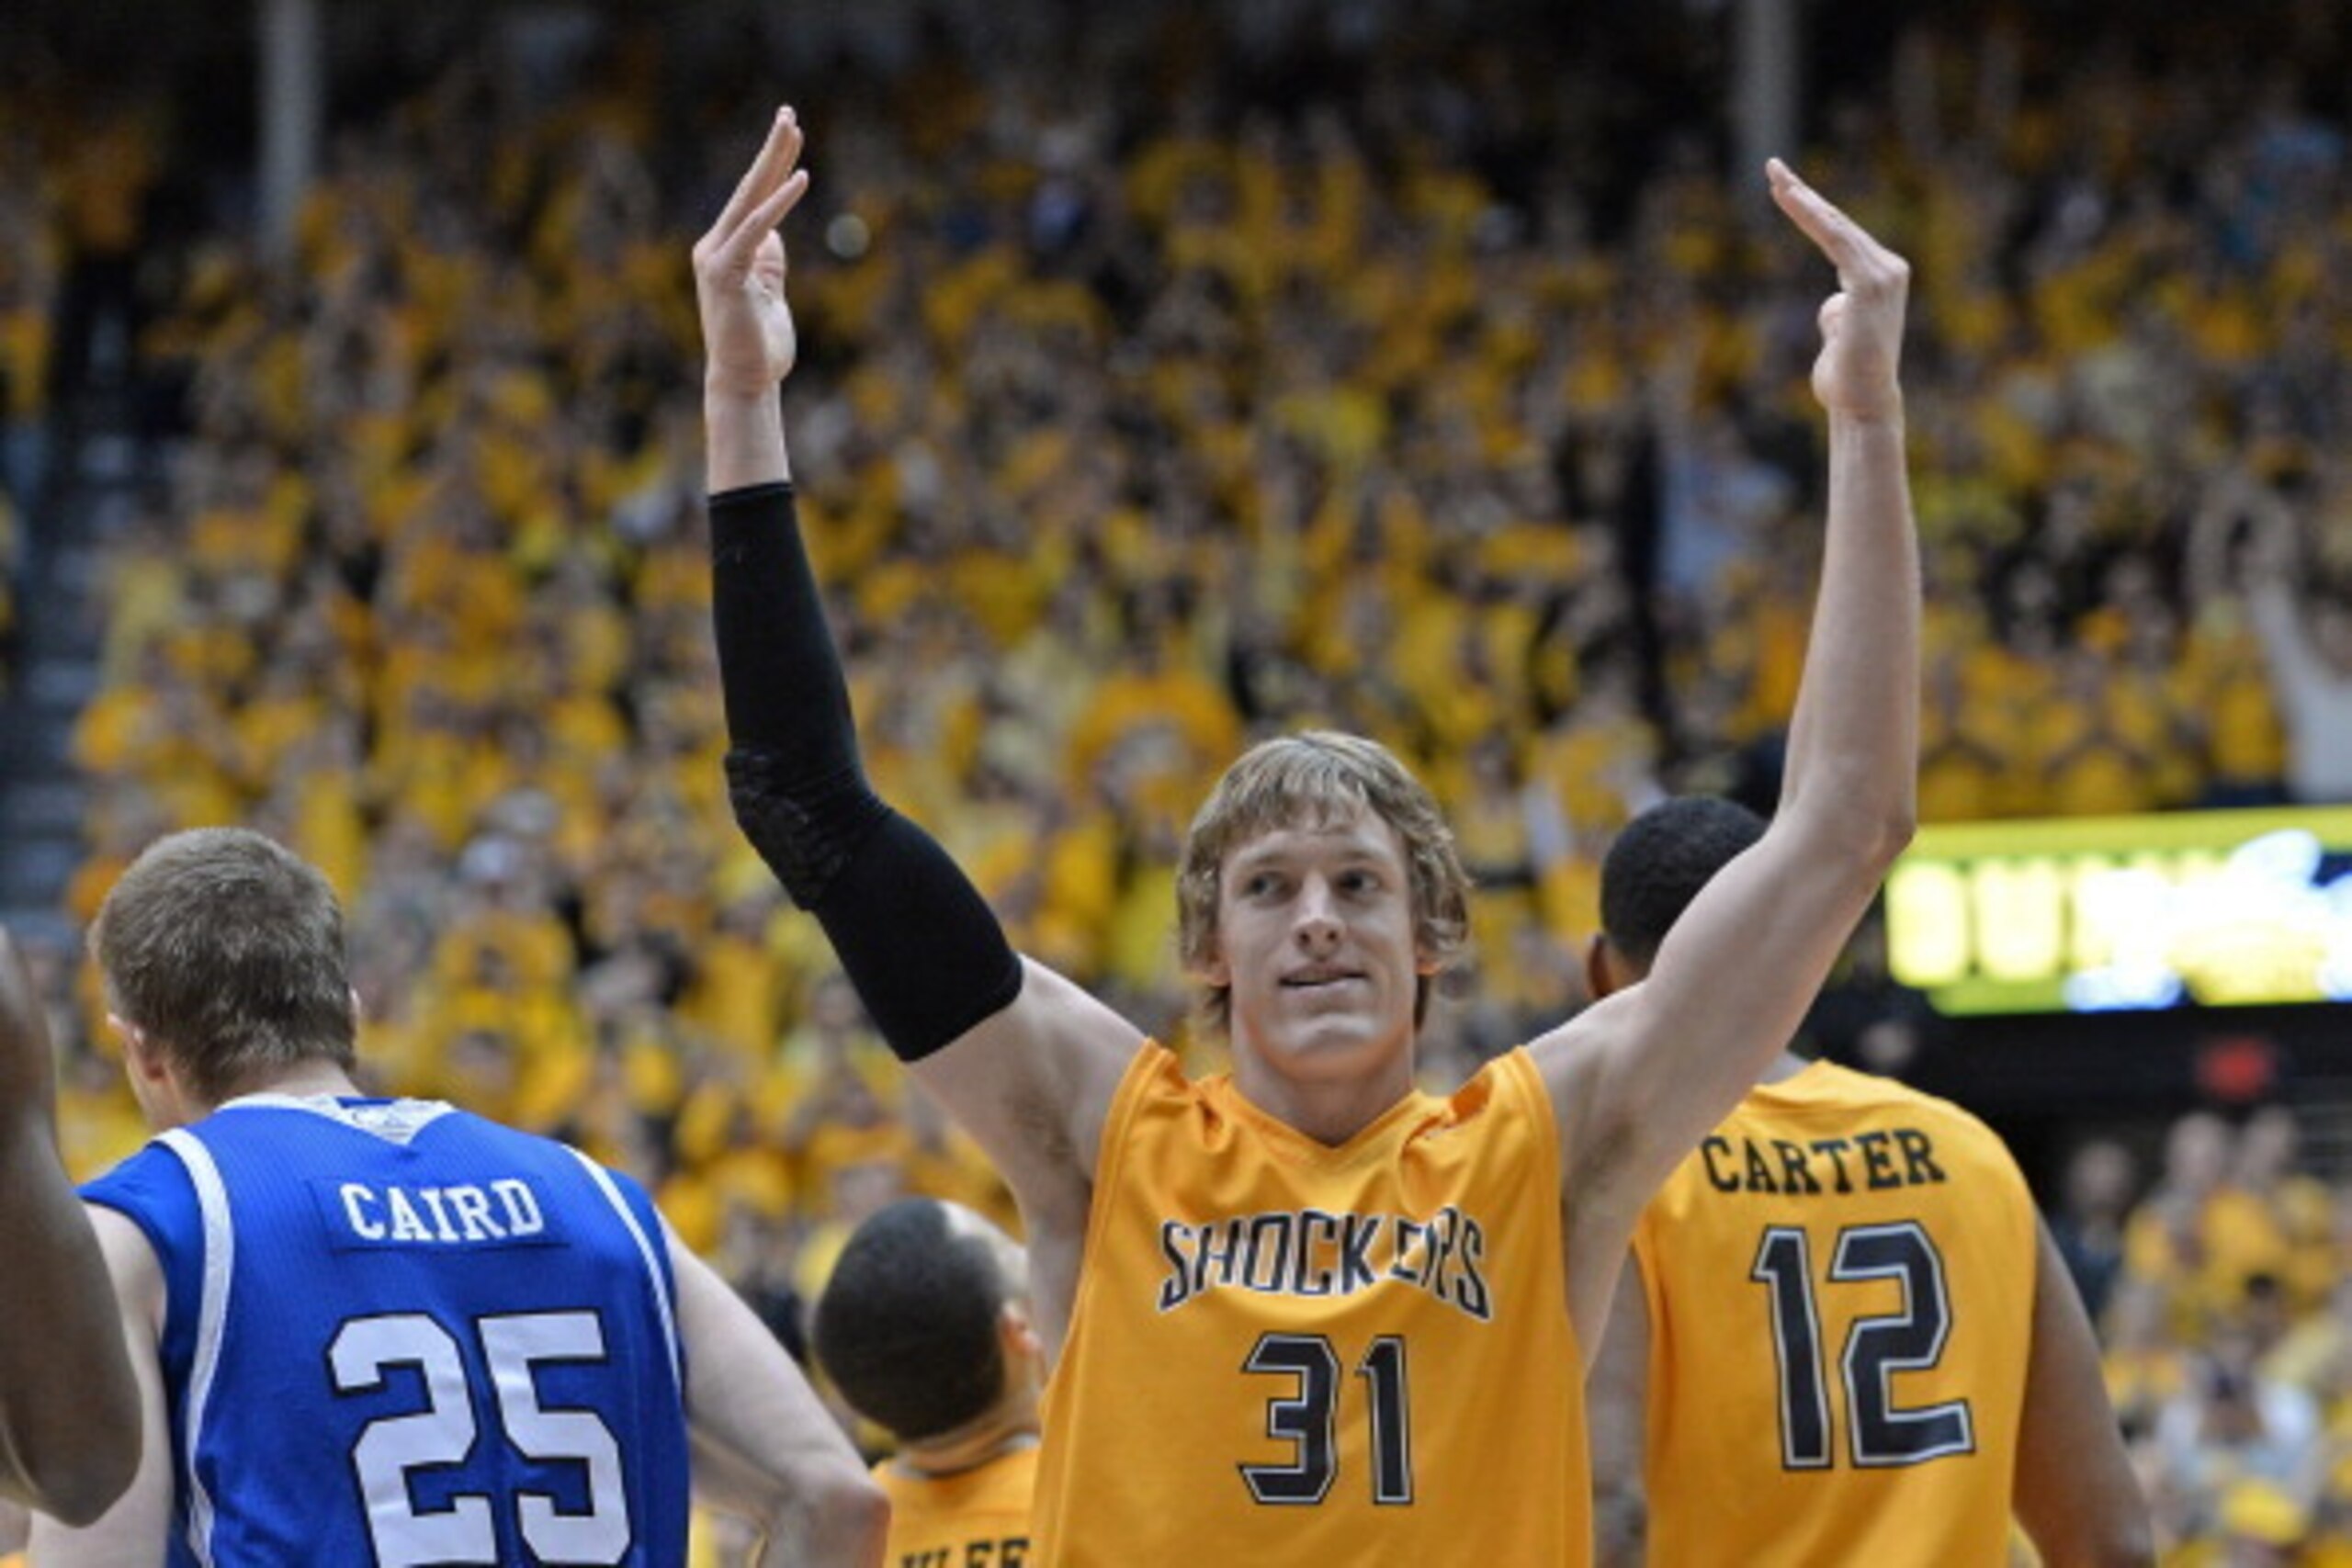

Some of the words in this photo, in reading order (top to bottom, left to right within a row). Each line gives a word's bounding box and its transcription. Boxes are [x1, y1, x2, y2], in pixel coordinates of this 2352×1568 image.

[339, 1179, 545, 1244] CAIRD
[1701, 1128, 1947, 1195] CARTER
[1237, 1332, 1414, 1506] 31
[1749, 1219, 1975, 1470] 12
[325, 1311, 631, 1568] 25
